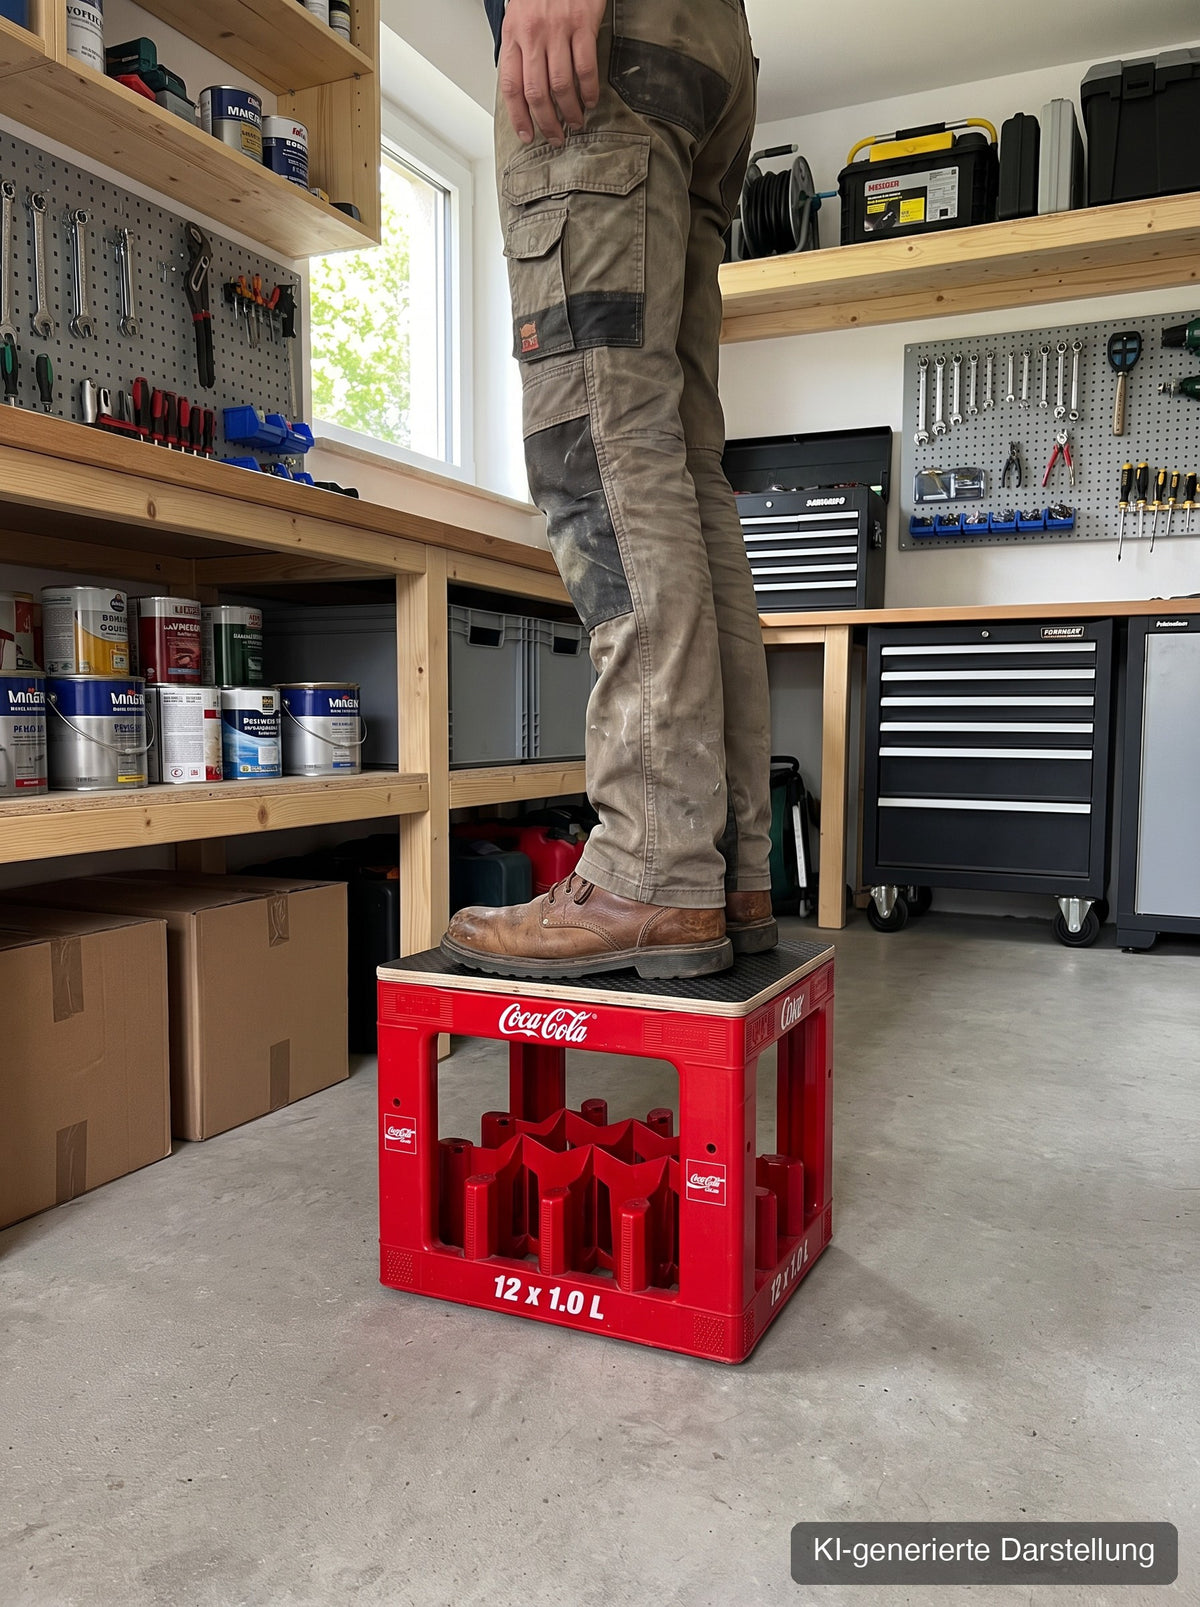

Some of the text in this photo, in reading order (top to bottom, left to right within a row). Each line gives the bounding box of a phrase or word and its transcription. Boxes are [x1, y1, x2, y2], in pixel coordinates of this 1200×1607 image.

[499, 1003, 592, 1043] Coca-Cola
[771, 1239, 809, 1307] 12 x 1.0 L
[494, 1274, 604, 1320] 12 x 1.0 L
